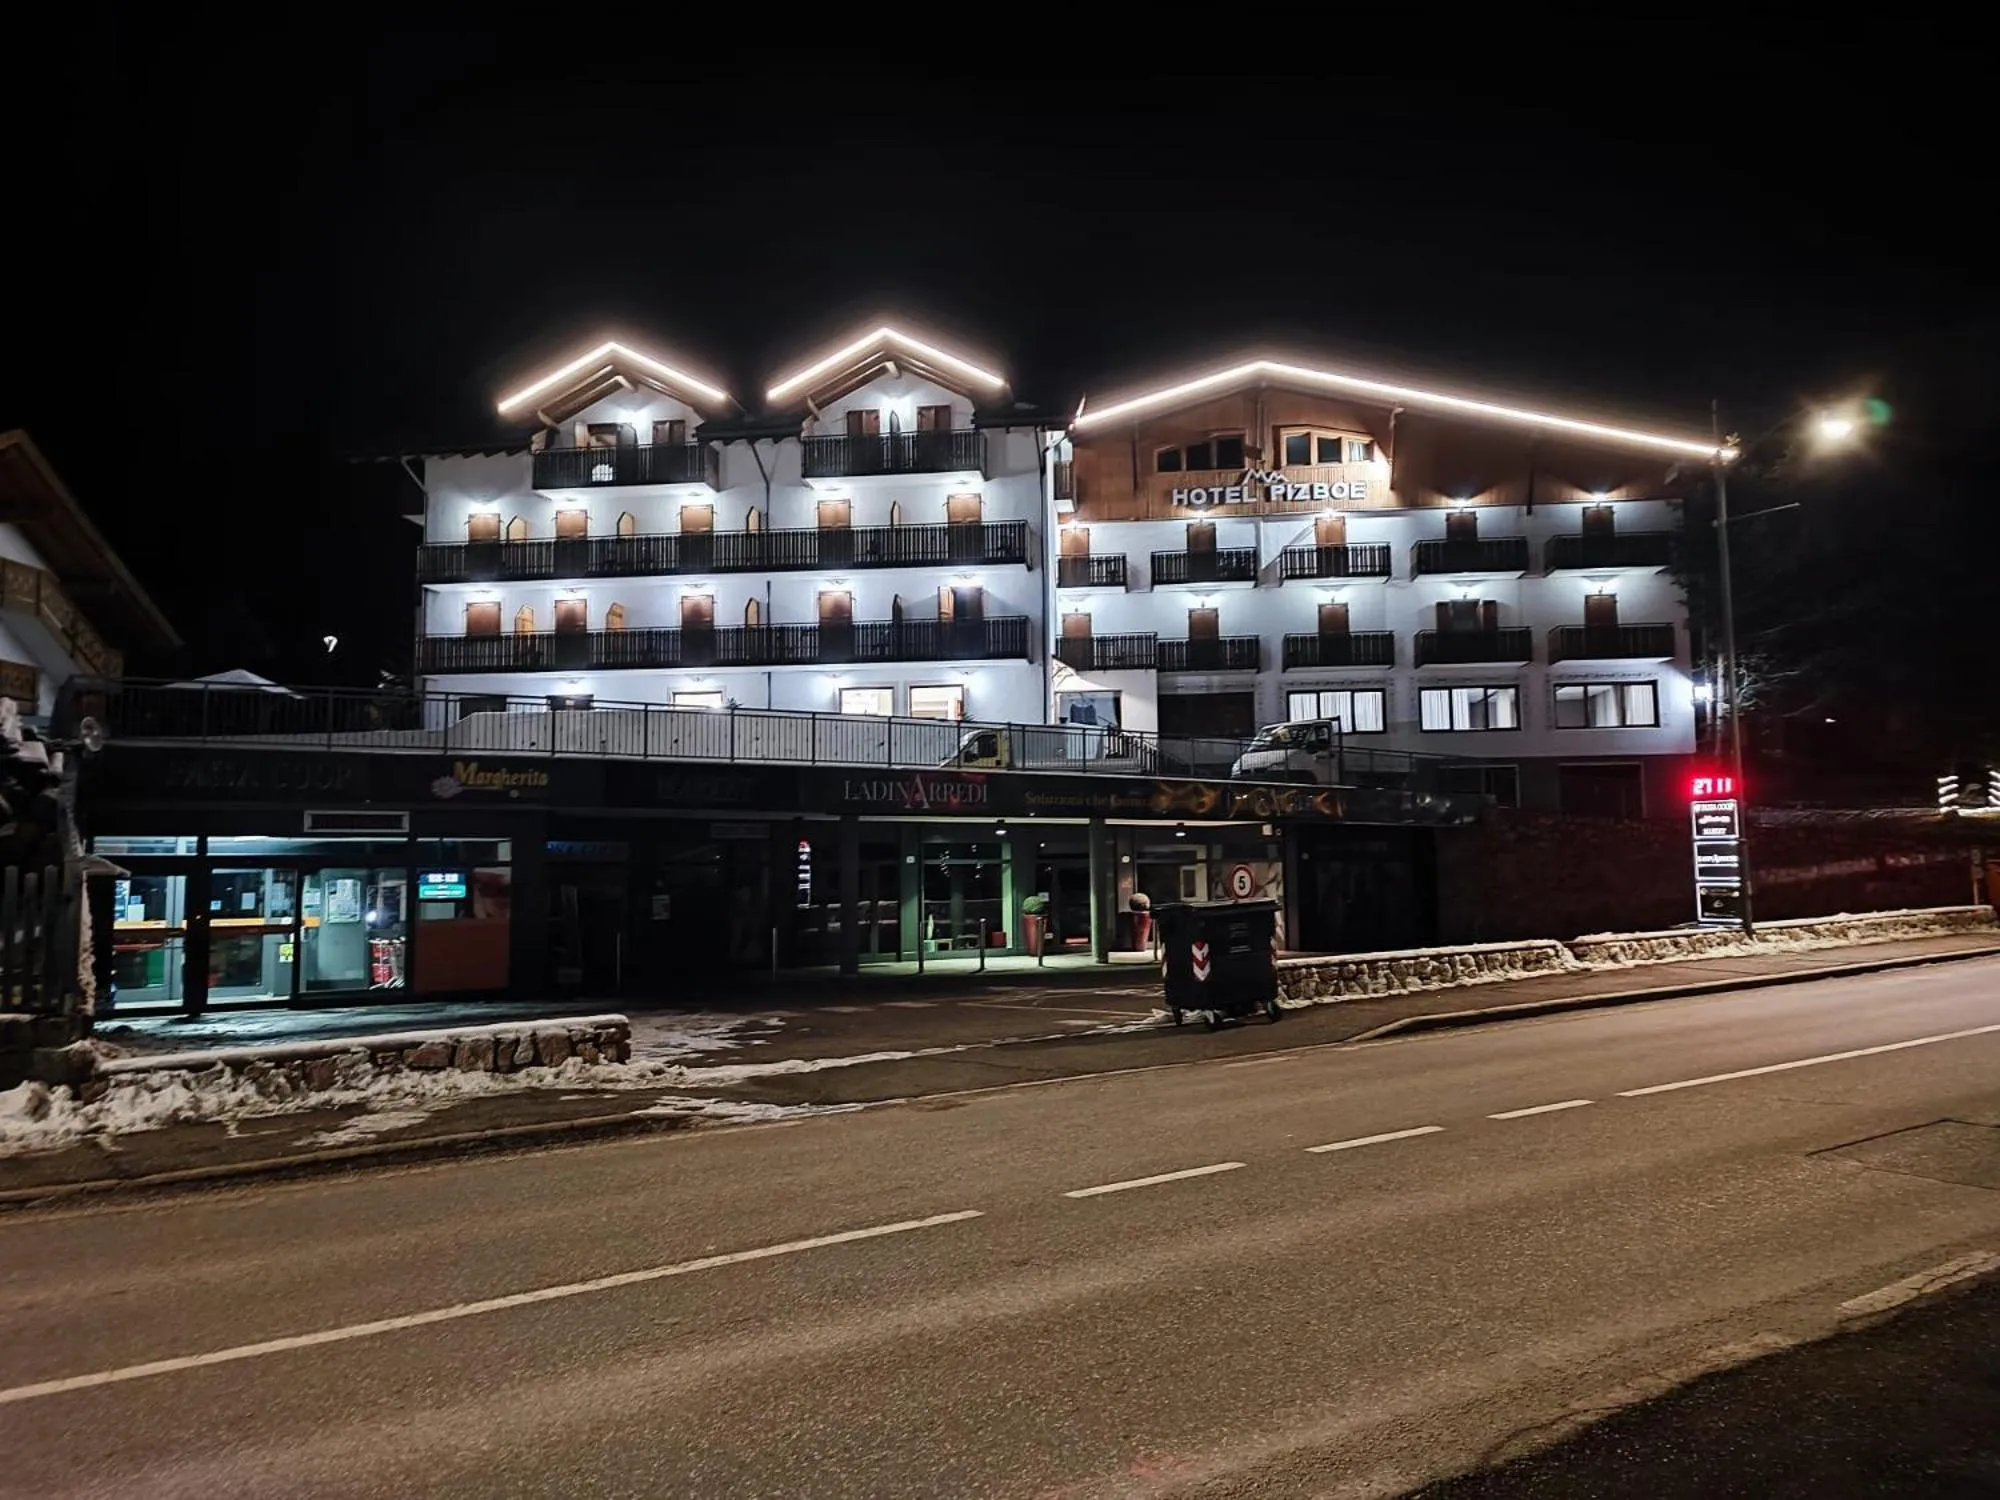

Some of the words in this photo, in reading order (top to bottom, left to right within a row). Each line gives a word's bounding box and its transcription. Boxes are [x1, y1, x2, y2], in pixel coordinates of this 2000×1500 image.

[1172, 486, 1257, 506] HOTEL
[1271, 481, 1368, 502] PIZBOE
[1238, 875, 1246, 890] 5
